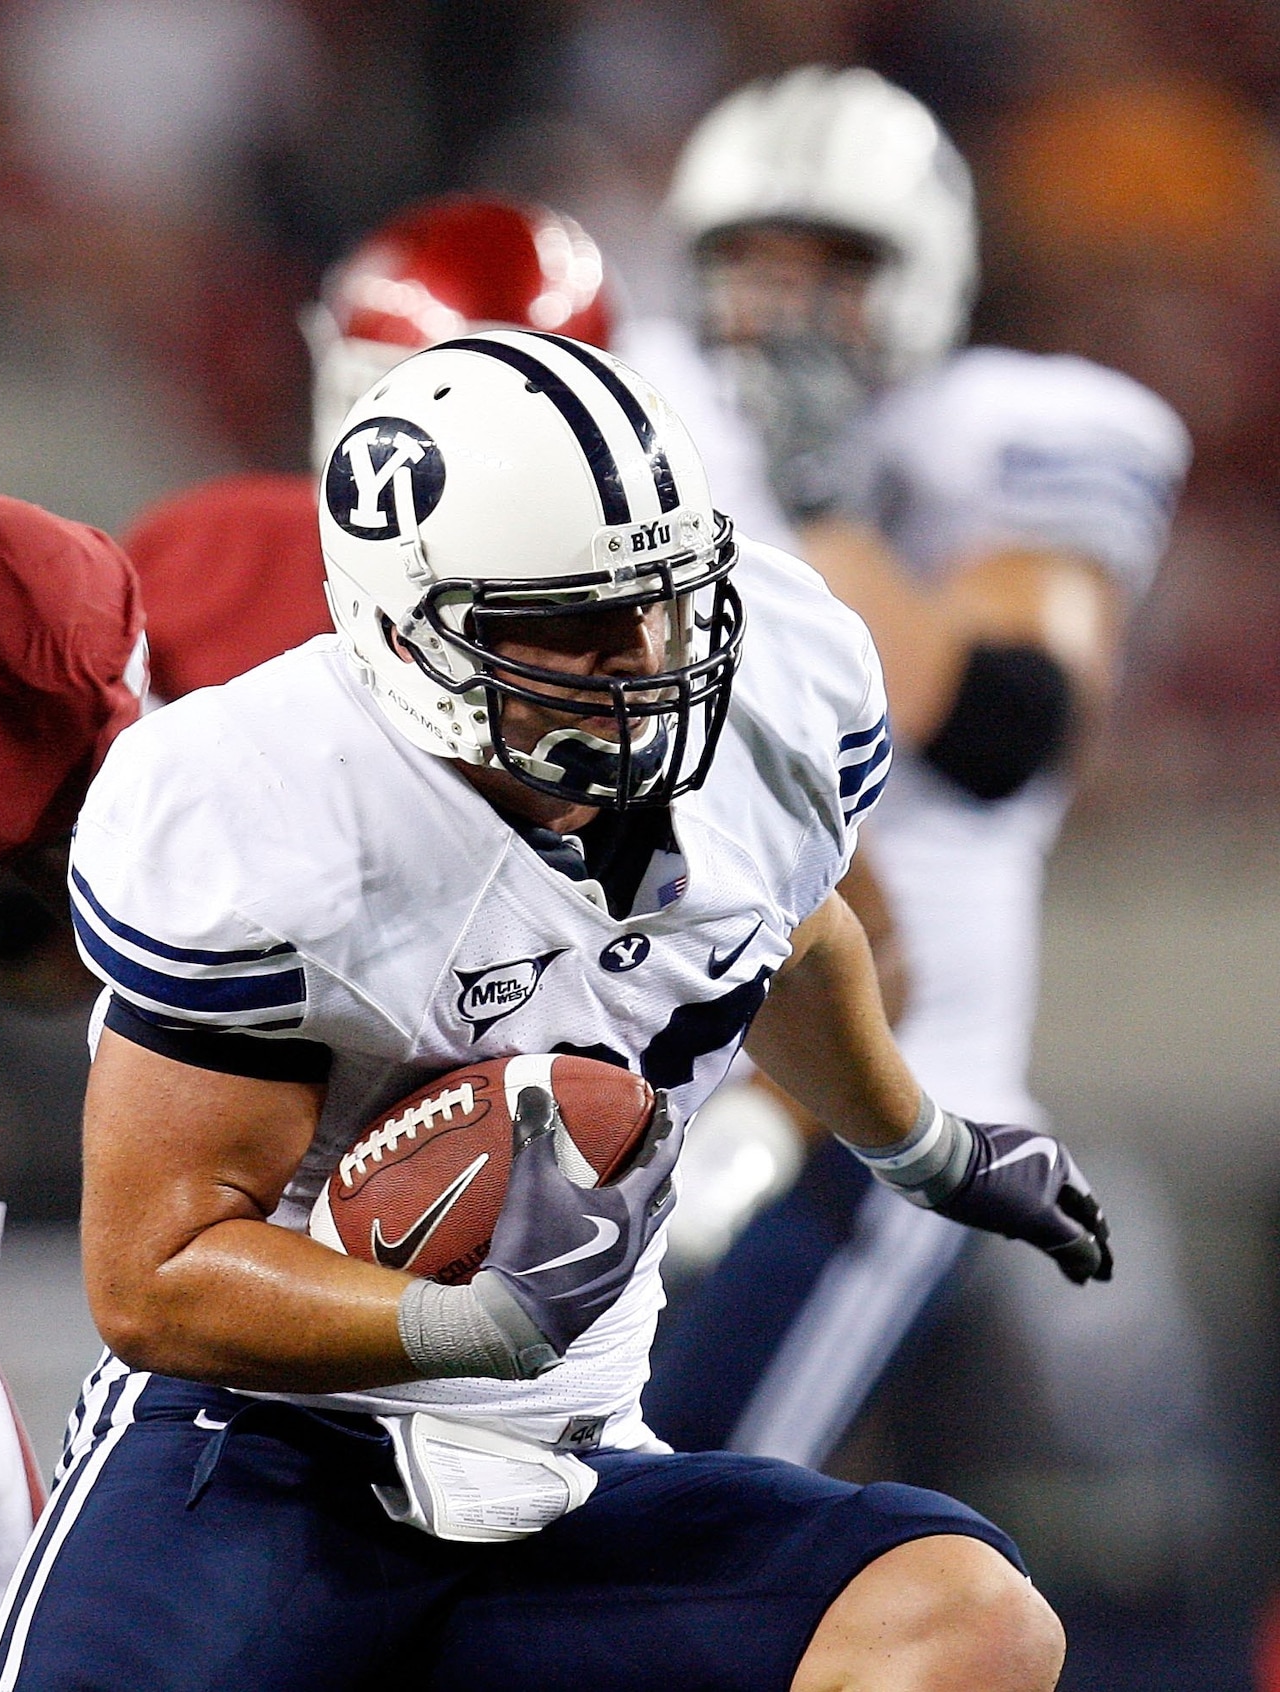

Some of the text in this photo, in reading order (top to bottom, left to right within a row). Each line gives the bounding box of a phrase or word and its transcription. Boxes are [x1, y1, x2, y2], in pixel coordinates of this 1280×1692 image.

[341, 426, 426, 528] Y
[631, 521, 671, 552] BYU
[387, 689, 443, 740] ADAMS
[608, 938, 644, 968] Y
[497, 987, 530, 1004] WEST
